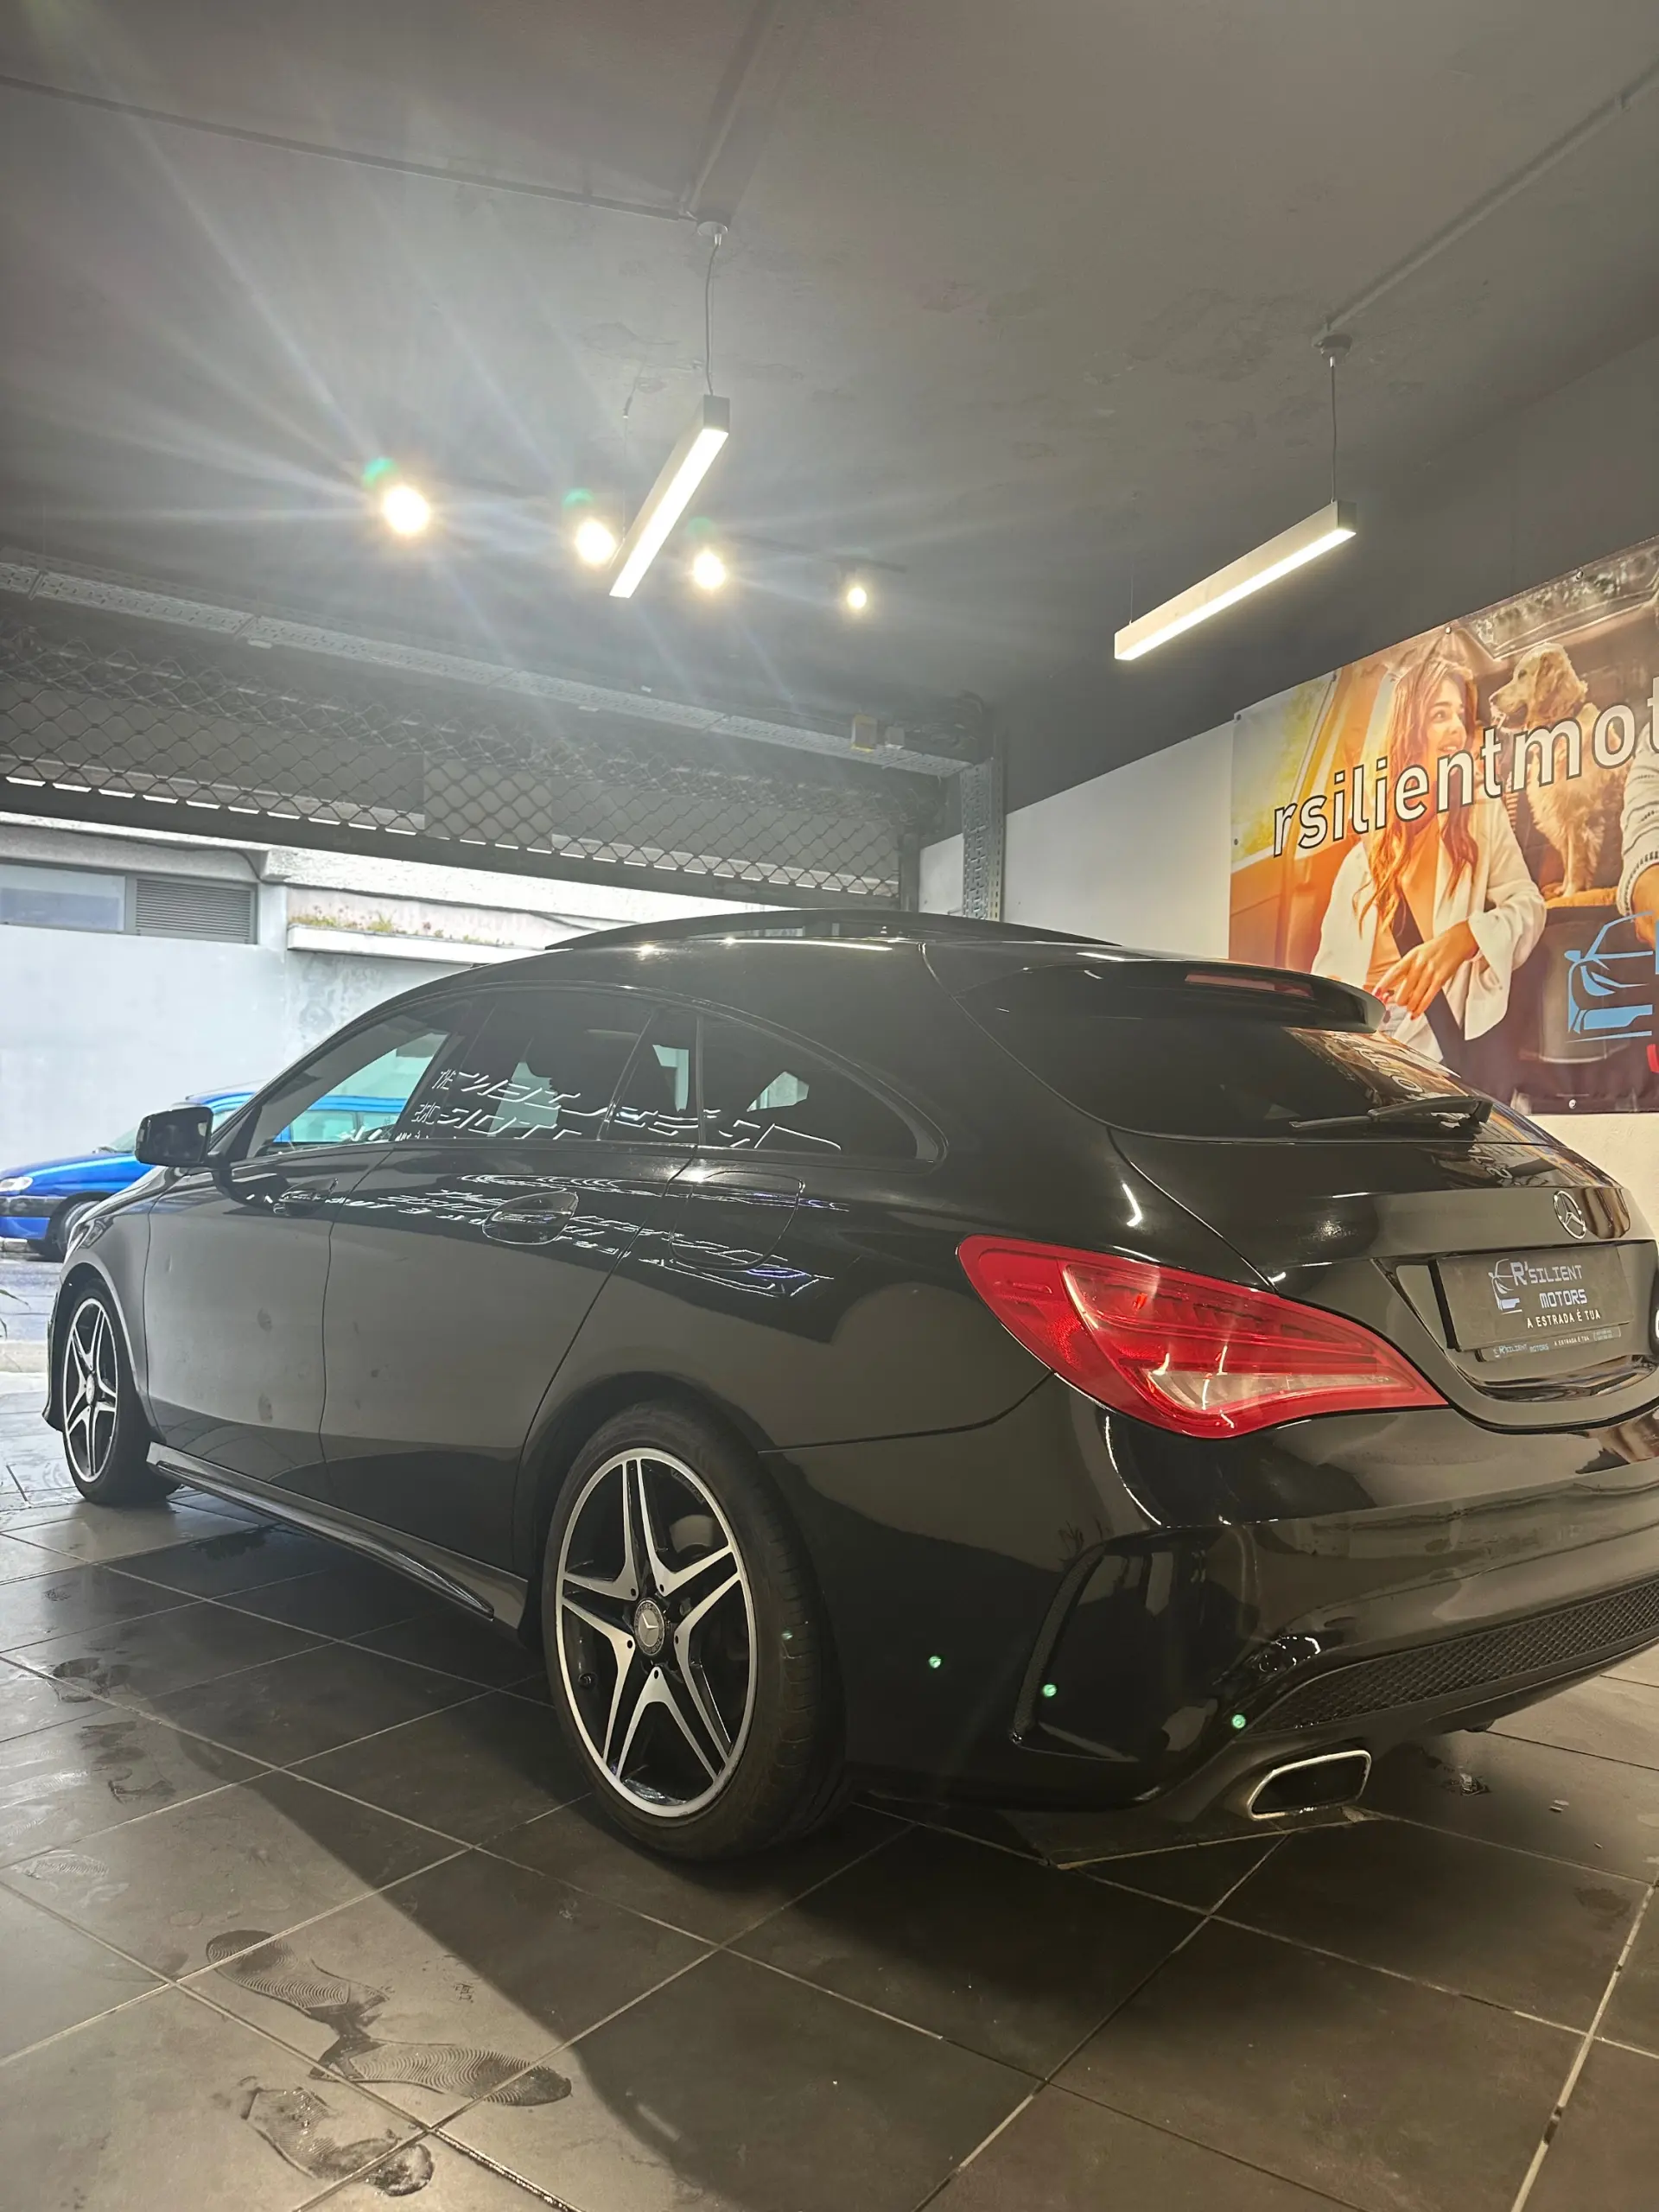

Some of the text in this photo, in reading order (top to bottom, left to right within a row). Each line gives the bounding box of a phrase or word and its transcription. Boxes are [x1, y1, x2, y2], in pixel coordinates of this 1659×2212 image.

[1539, 1288, 1588, 1309] MOTORS
[1526, 1308, 1601, 1329] A ESTRADA É TUA
